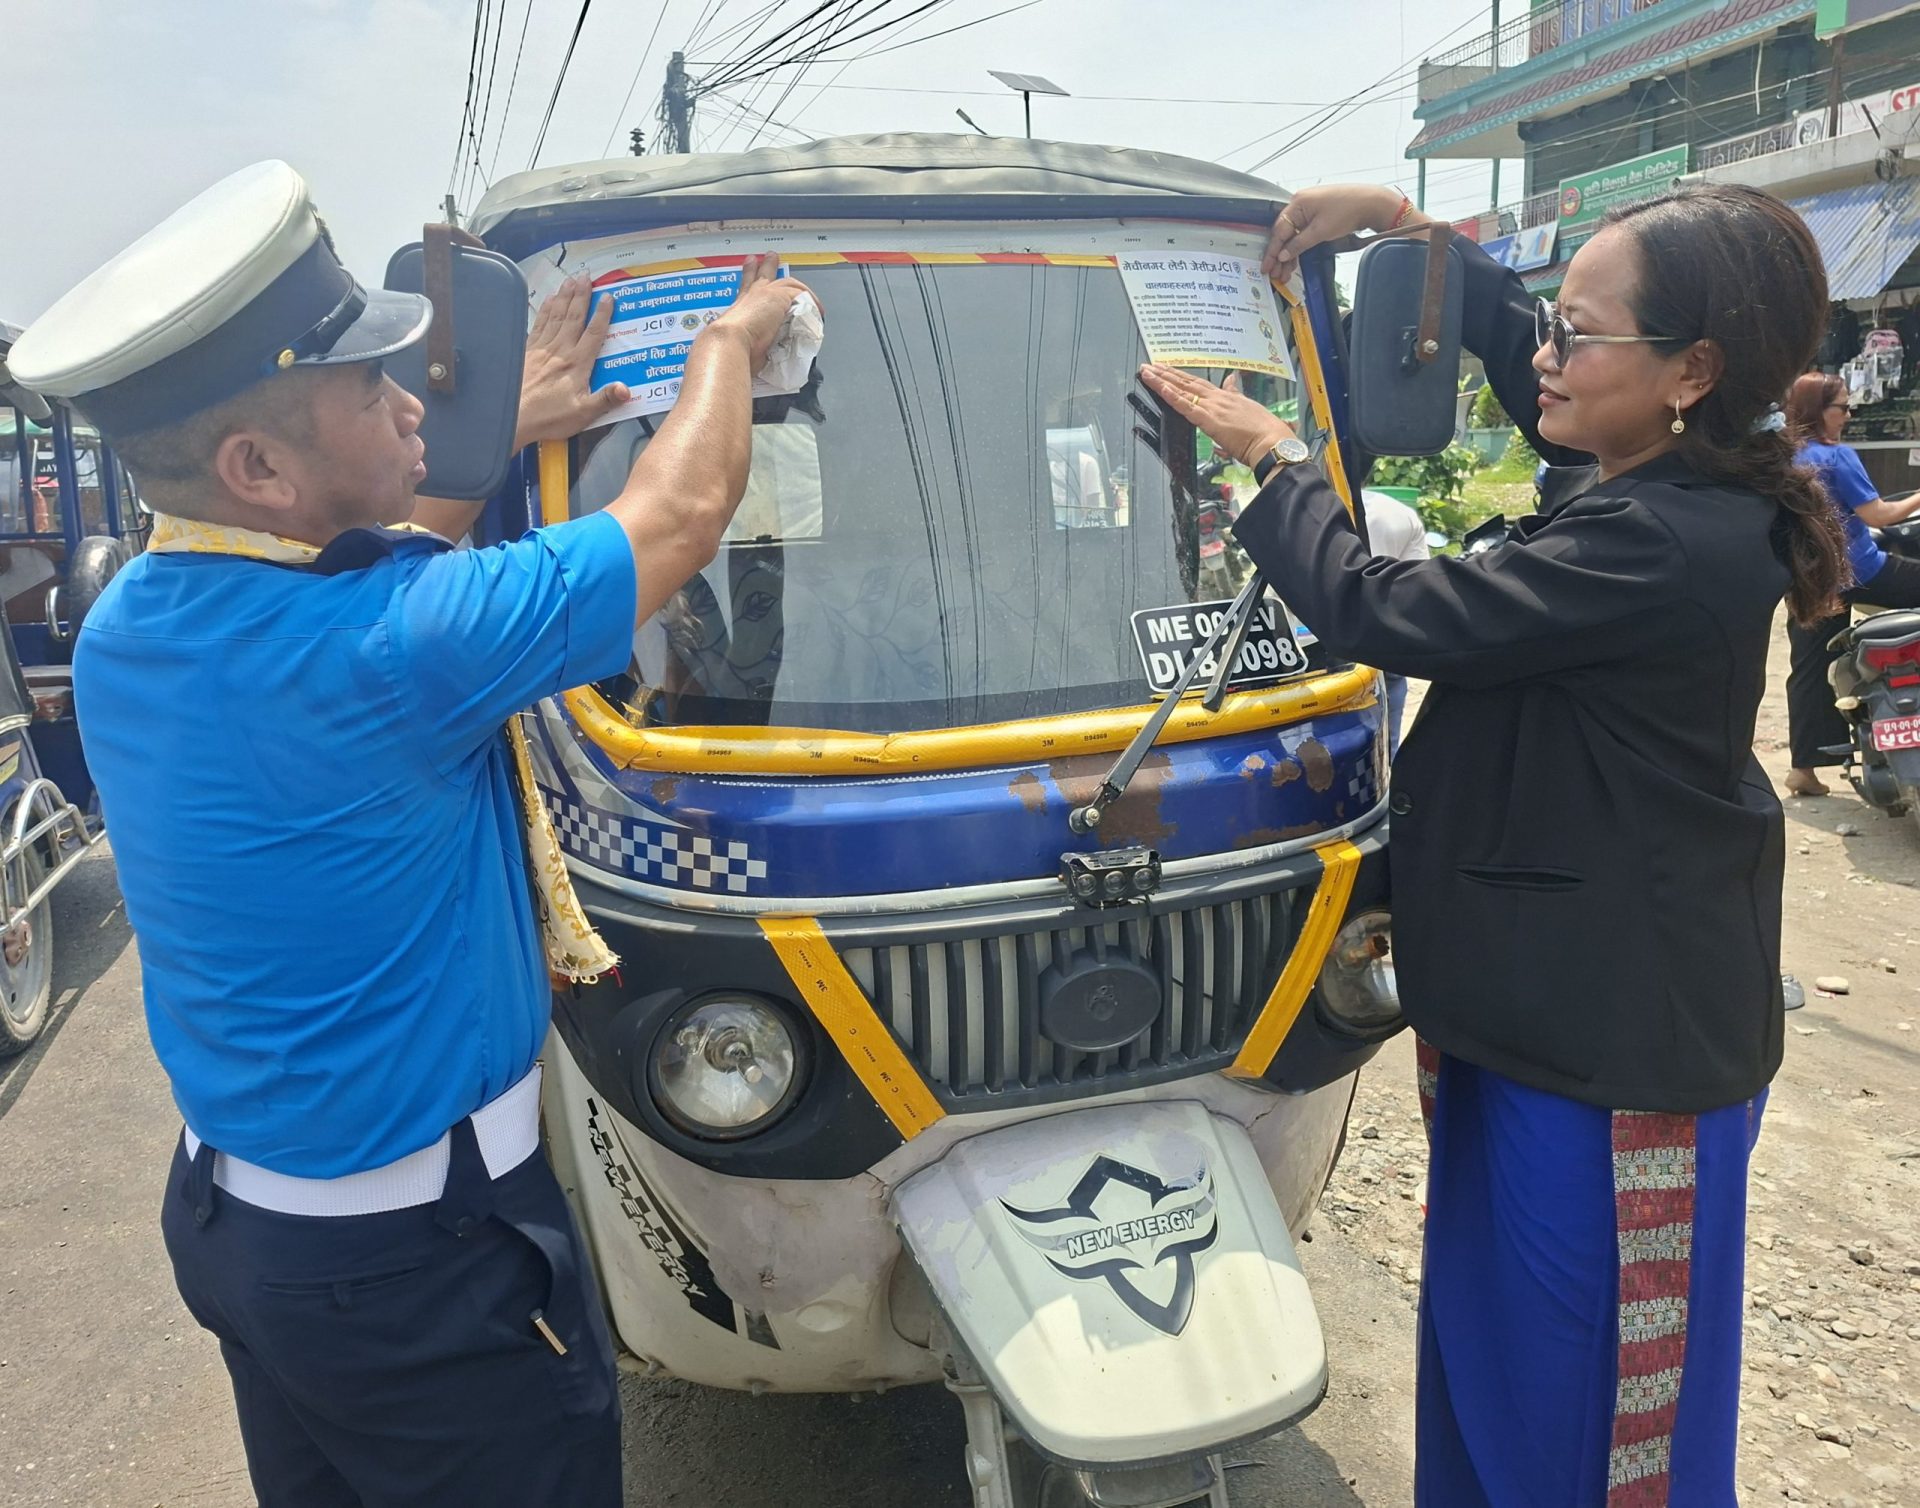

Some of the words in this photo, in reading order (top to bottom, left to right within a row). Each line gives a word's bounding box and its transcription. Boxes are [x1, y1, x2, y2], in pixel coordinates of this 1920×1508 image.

[1218, 261, 1233, 273] JCI
[687, 275, 717, 285] पालना
[619, 301, 635, 313] लेन
[683, 290, 712, 301] कायम
[642, 320, 662, 332] JCI
[647, 386, 667, 399] JCI
[1146, 615, 1193, 644] ME
[1195, 610, 1240, 639] 00
[1042, 738, 1055, 748] 3M
[587, 1122, 627, 1200] NEW
[1066, 1226, 1114, 1259] NEW
[1116, 1209, 1196, 1245] ENERGY
[620, 1196, 708, 1299] ENERGY
